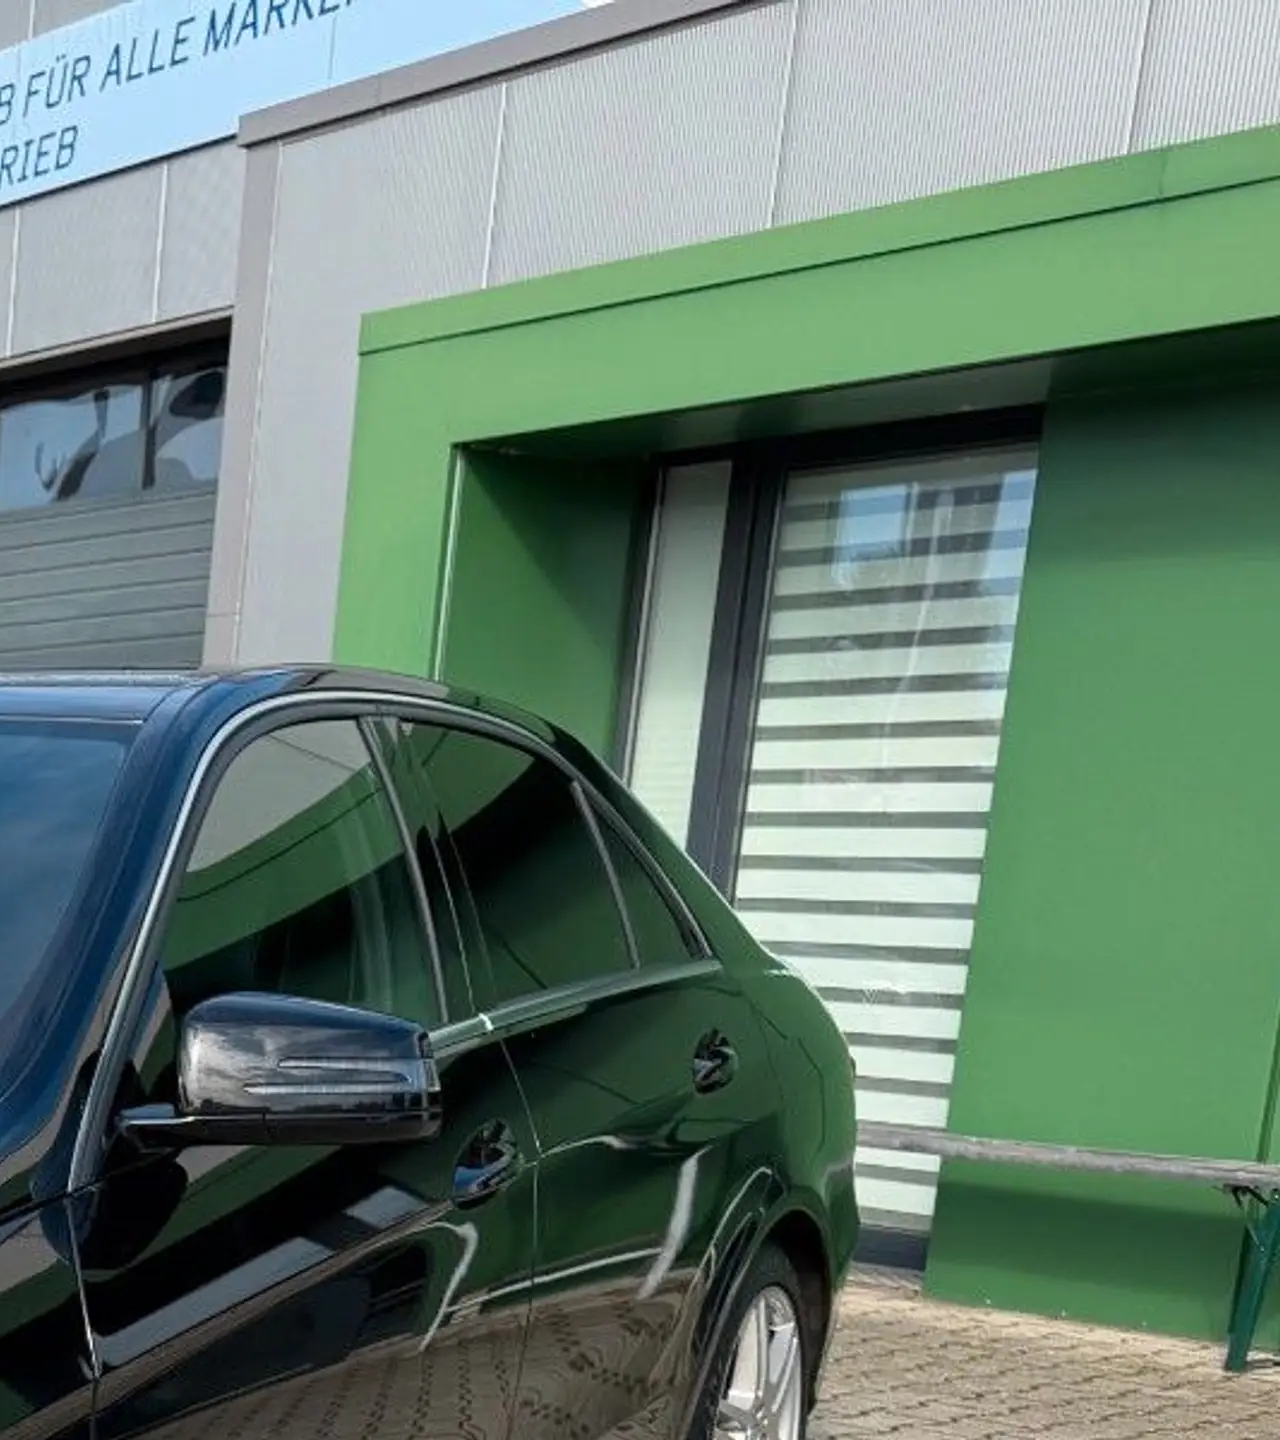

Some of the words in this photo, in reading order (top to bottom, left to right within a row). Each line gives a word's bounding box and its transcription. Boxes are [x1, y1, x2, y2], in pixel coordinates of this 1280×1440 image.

[23, 54, 91, 118] FÜR
[99, 16, 196, 93] ALLE
[203, 0, 352, 57] MAR
